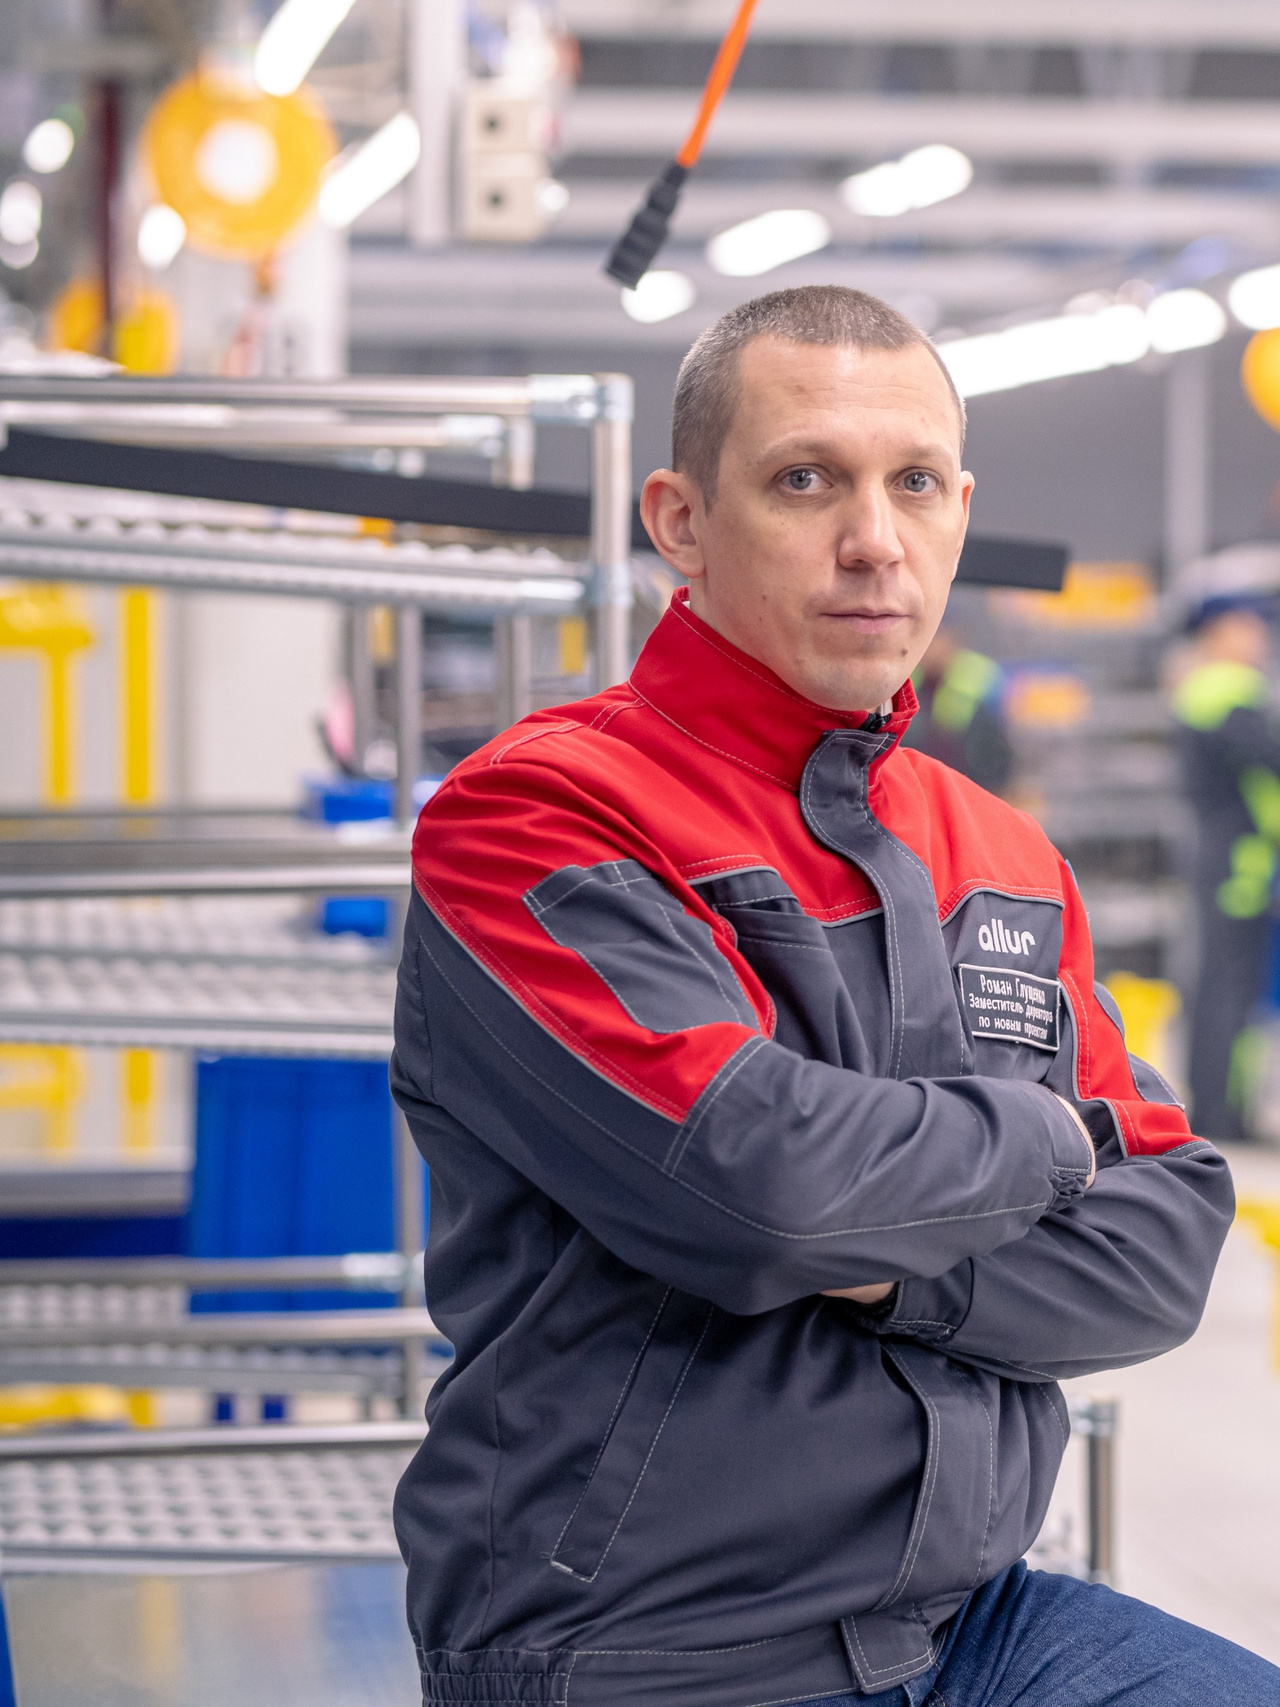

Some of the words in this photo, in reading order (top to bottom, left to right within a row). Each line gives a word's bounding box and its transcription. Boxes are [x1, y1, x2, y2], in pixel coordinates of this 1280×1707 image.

[978, 918, 1036, 956] allur
[980, 974, 1012, 995] Роман
[969, 993, 1024, 1014] Заместитель
[979, 1015, 990, 1028] по
[994, 1017, 1021, 1032] новым
